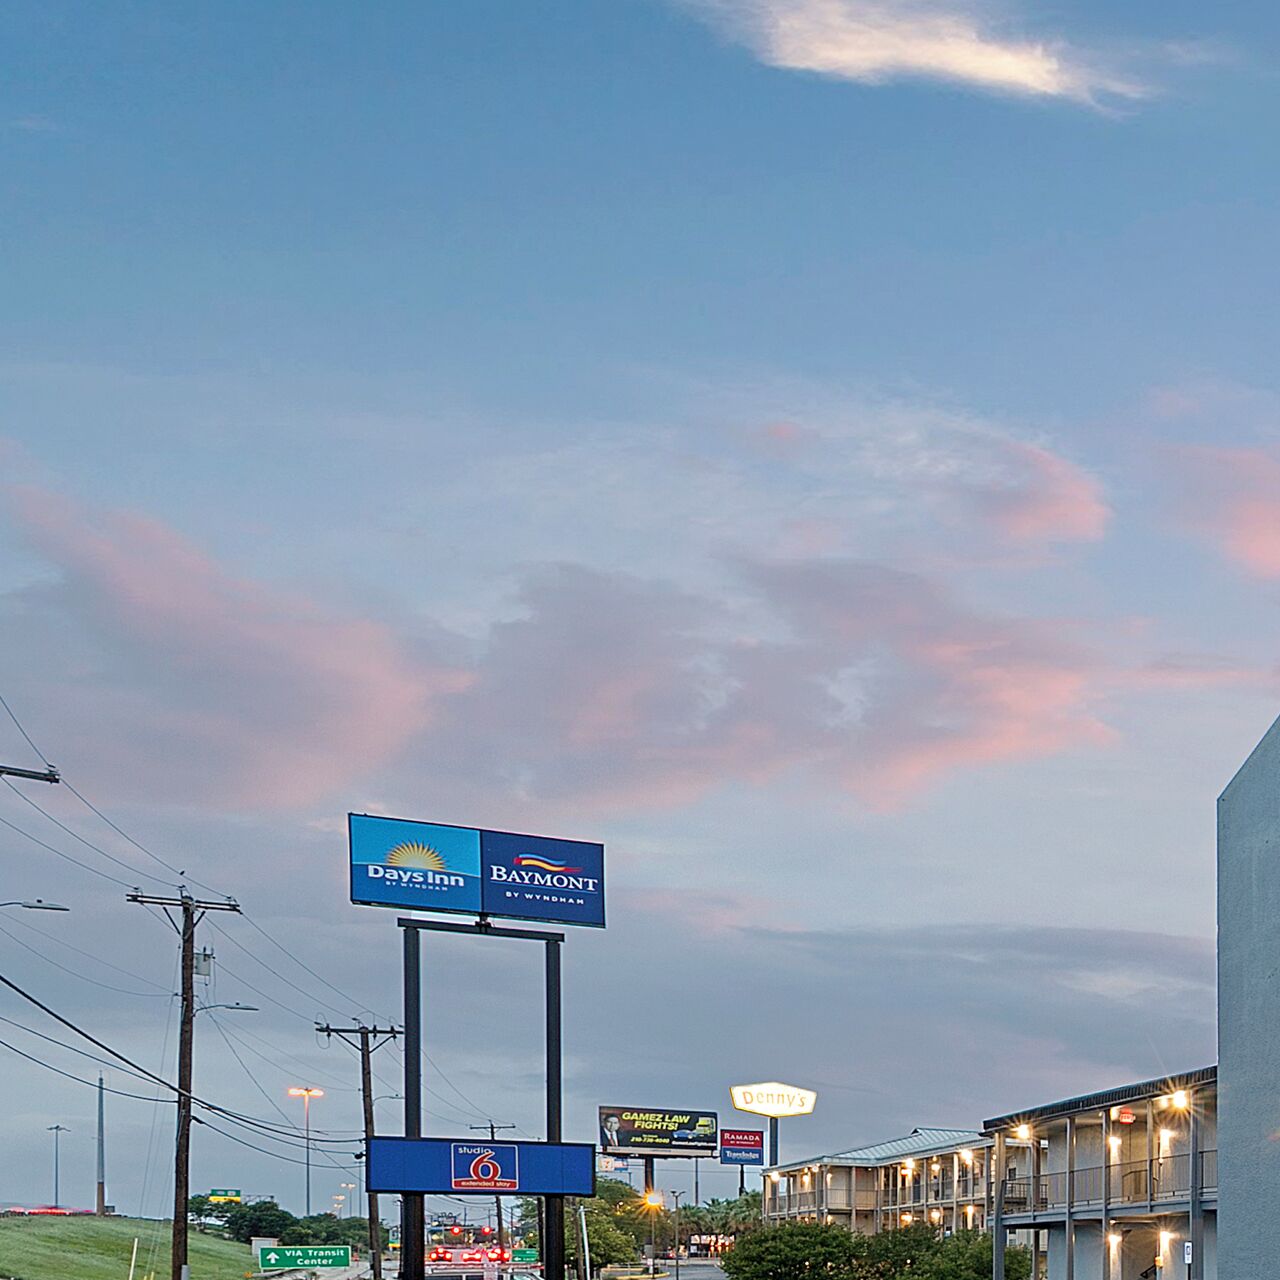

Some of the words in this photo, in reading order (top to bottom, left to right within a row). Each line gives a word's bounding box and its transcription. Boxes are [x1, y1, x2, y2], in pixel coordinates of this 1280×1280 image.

[367, 865, 427, 883] Days
[427, 872, 465, 887] Inn
[490, 865, 598, 891] BAYMONT
[400, 883, 448, 891] WYNDHAM
[525, 893, 584, 904] WYNDHAM
[742, 1091, 807, 1108] Denny's
[622, 1112, 663, 1121] GAMEZ
[665, 1114, 690, 1123] LAW
[634, 1121, 678, 1130] FIGHTS!
[724, 1133, 760, 1141] RAMADA
[470, 1151, 501, 1182] 6
